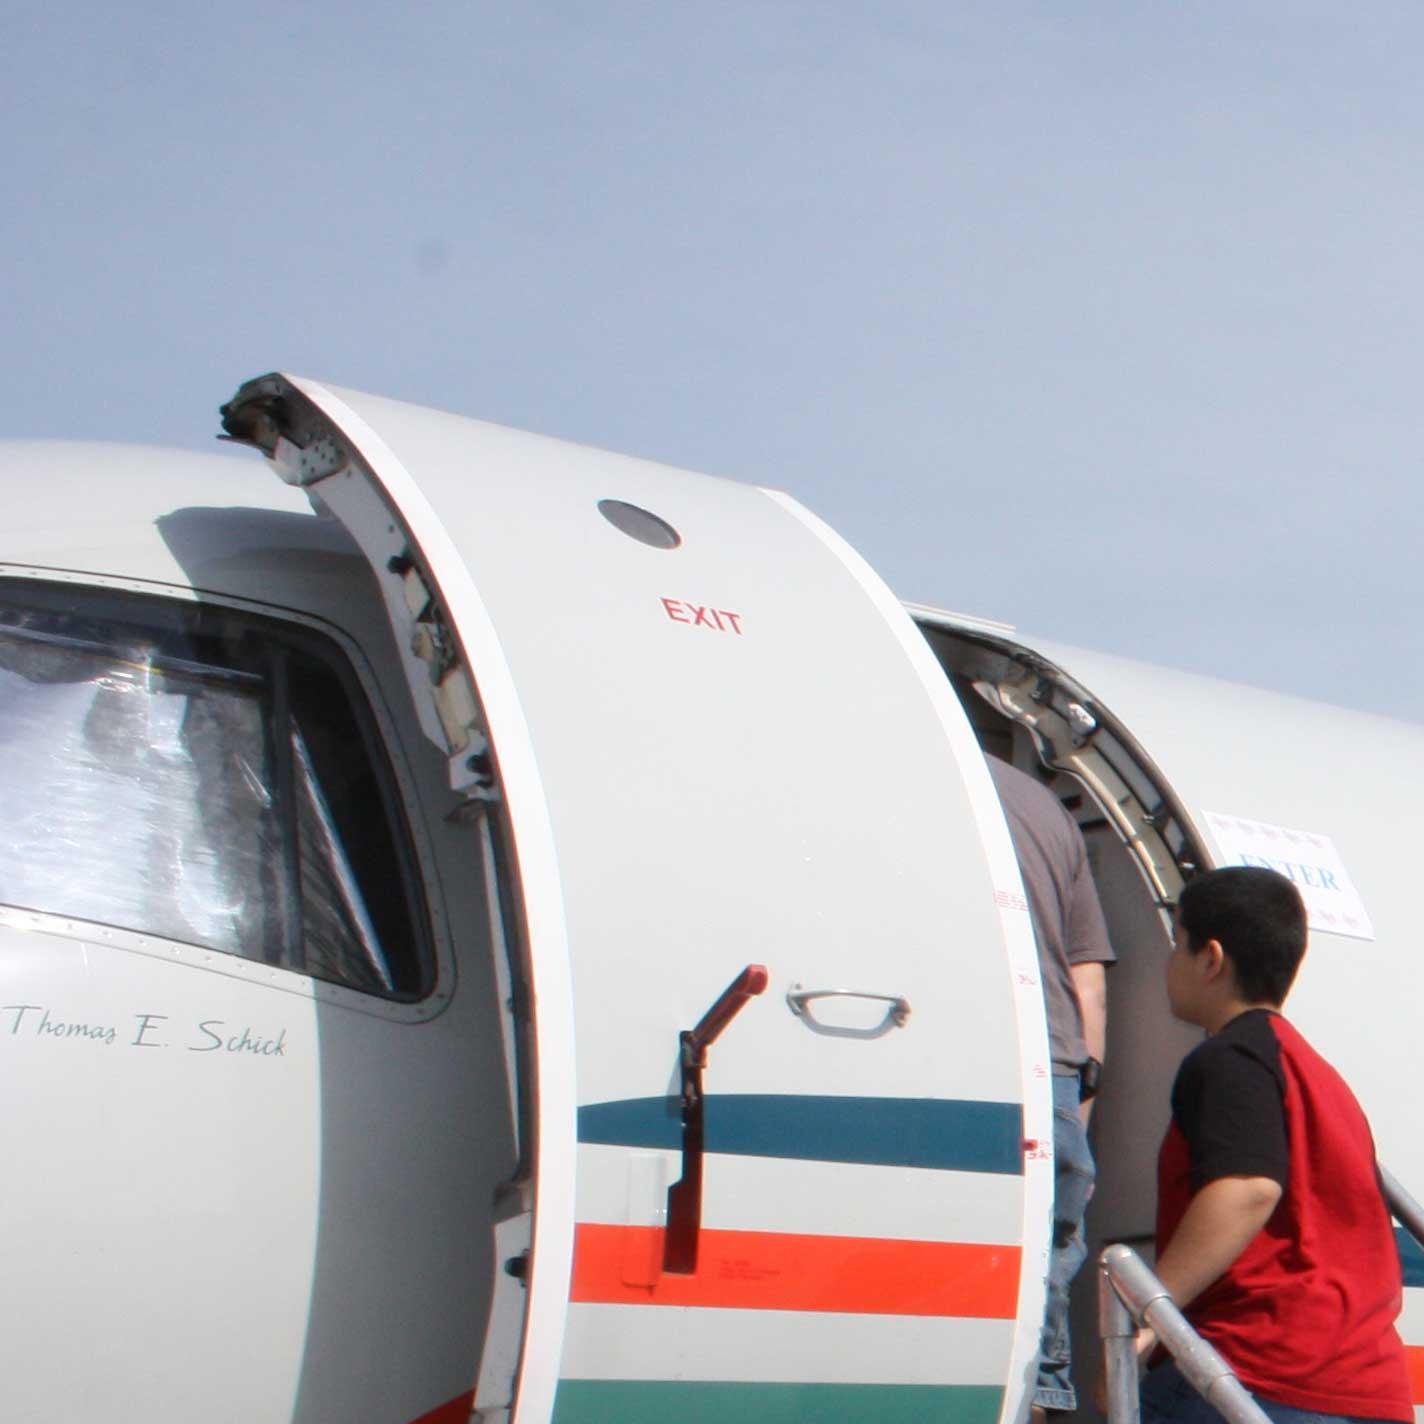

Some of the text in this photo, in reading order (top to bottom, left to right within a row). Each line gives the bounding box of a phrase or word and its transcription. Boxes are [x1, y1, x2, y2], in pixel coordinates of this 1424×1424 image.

[660, 597, 741, 635] EXIT
[3, 1005, 286, 1057] Thomas E. Schick
